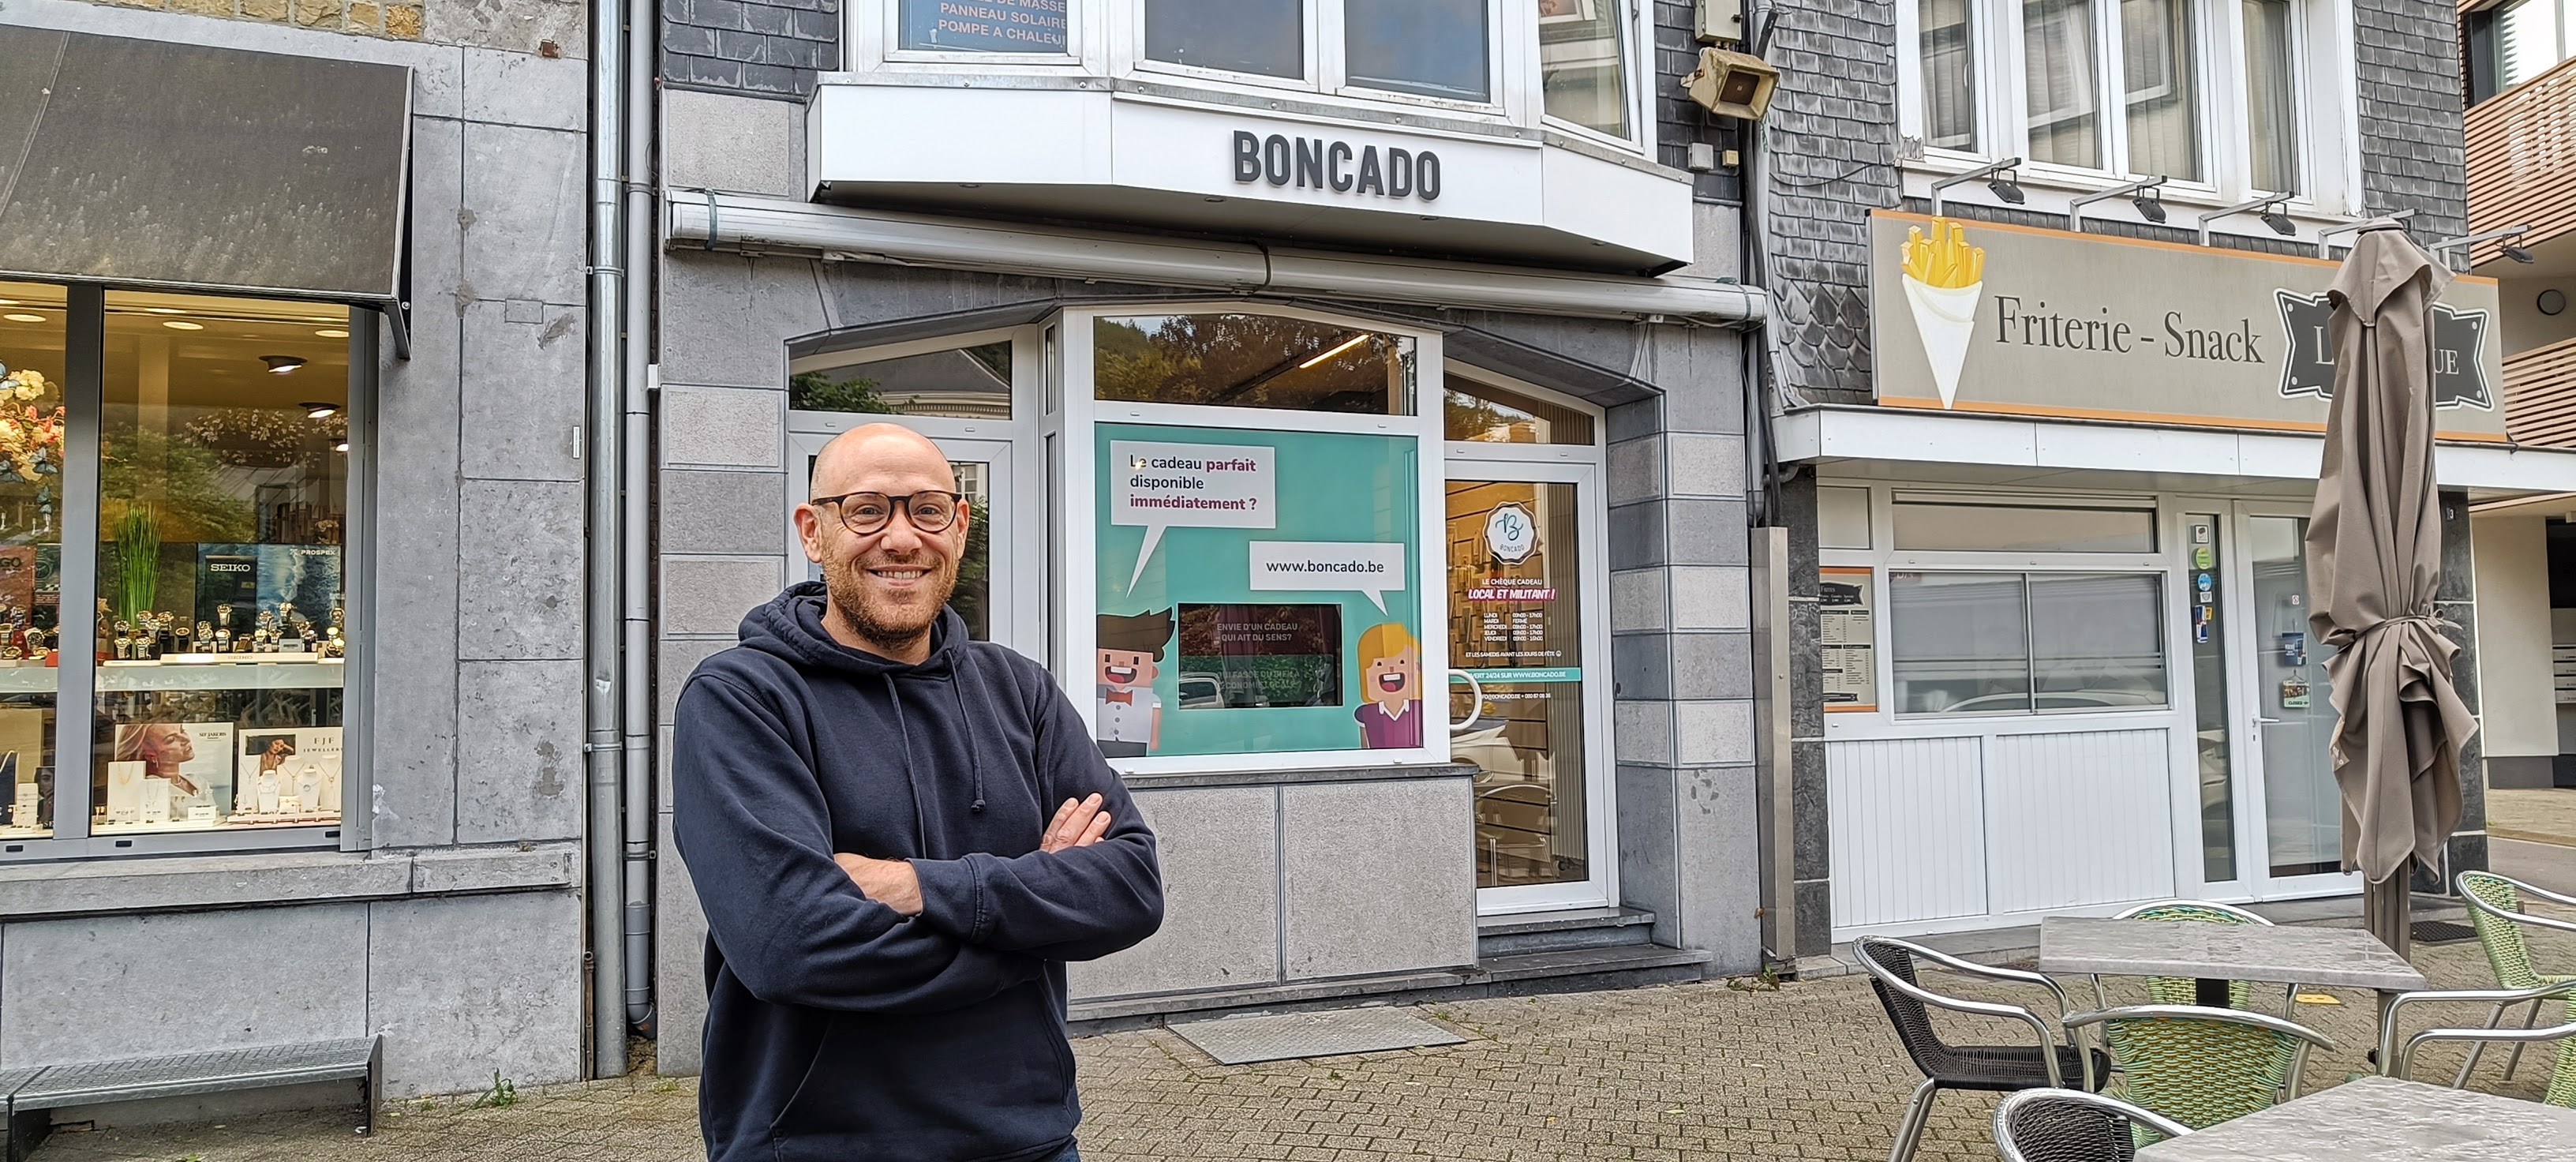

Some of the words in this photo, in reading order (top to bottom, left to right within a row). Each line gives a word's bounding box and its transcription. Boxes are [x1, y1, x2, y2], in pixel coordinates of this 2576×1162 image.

[940, 2, 1006, 21] PANNEAU
[1011, 12, 1065, 29] SOLAIRE
[938, 20, 989, 36] POMPE
[993, 26, 1003, 38] A
[1234, 130, 1440, 201] BONCADO
[1994, 295, 2131, 353] Friterie
[2164, 311, 2265, 363] Snack
[1130, 455, 1147, 467] Le
[1151, 456, 1201, 470] cadeau
[1206, 459, 1256, 473] parfait
[1130, 474, 1204, 490] disponible
[1130, 494, 1245, 510] immédiatement
[1249, 498, 1257, 510] ?
[1266, 560, 1384, 572] www.boncado.be
[1491, 577, 1515, 586] CHÈQUE
[1468, 589, 1495, 599] LOCAL
[1497, 589, 1509, 599] ET
[1510, 589, 1550, 599] MILITANT
